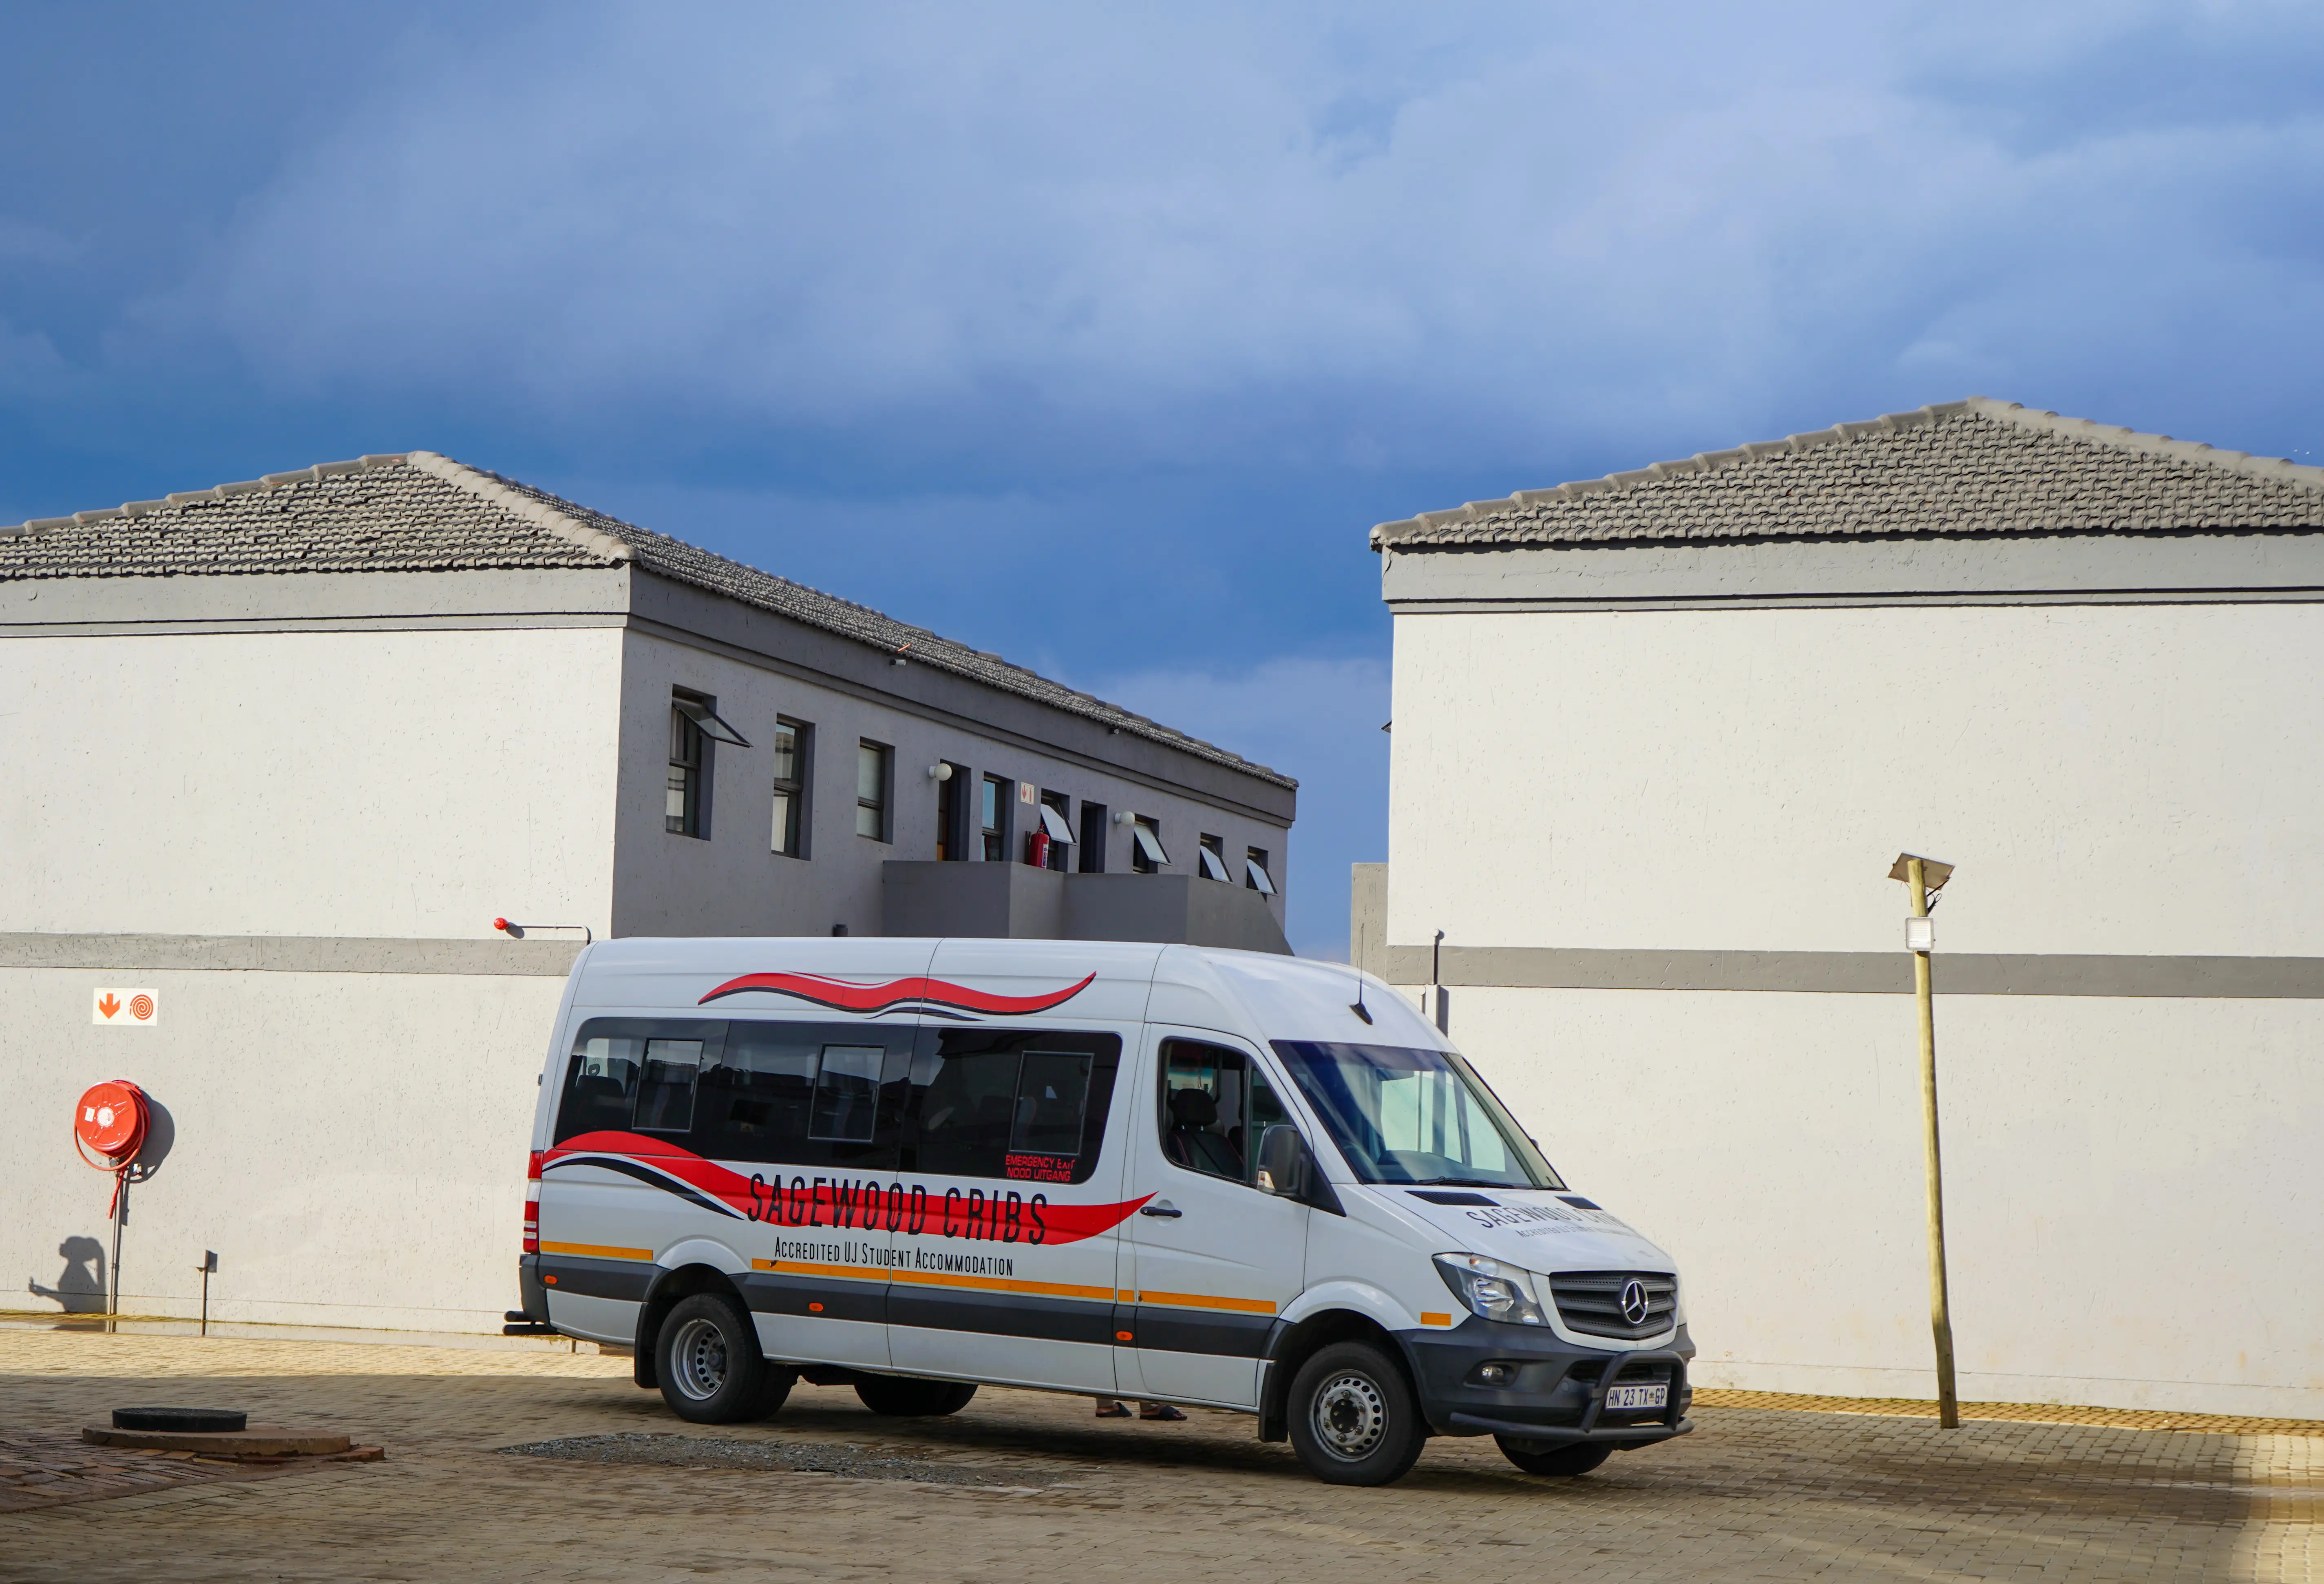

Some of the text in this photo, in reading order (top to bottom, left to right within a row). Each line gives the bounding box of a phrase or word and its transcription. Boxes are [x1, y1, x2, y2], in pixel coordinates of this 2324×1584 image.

[1005, 1155, 1055, 1168] EMERGENCY
[1007, 1167, 1071, 1181] NOOD UITGANG
[747, 1173, 1047, 1245] SAGEWOOD CRIBS
[1466, 1207, 1583, 1228] SAGEWOOD
[845, 1241, 857, 1263] UJ
[1608, 1387, 1665, 1407] HN 23 TX GP
